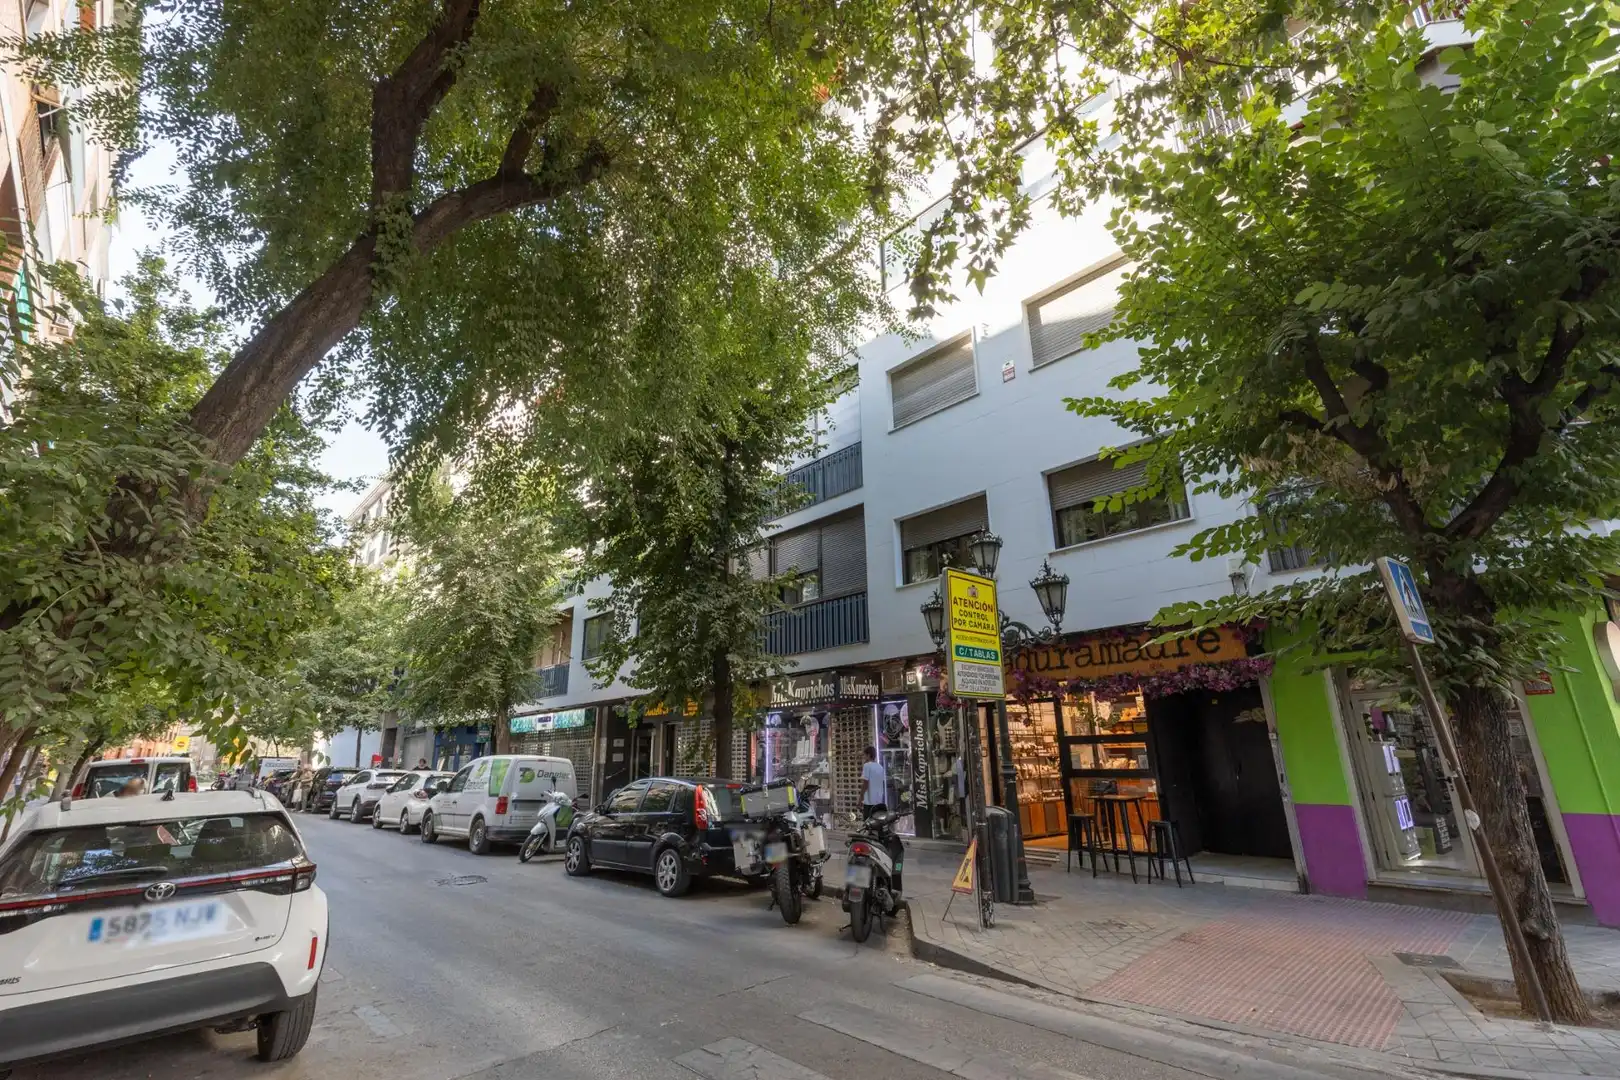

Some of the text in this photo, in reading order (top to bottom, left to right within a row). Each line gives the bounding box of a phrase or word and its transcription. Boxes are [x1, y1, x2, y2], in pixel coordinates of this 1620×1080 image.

[953, 596, 994, 613] ATENCIÓN
[953, 617, 967, 627] POR
[958, 609, 989, 622] CONTROL
